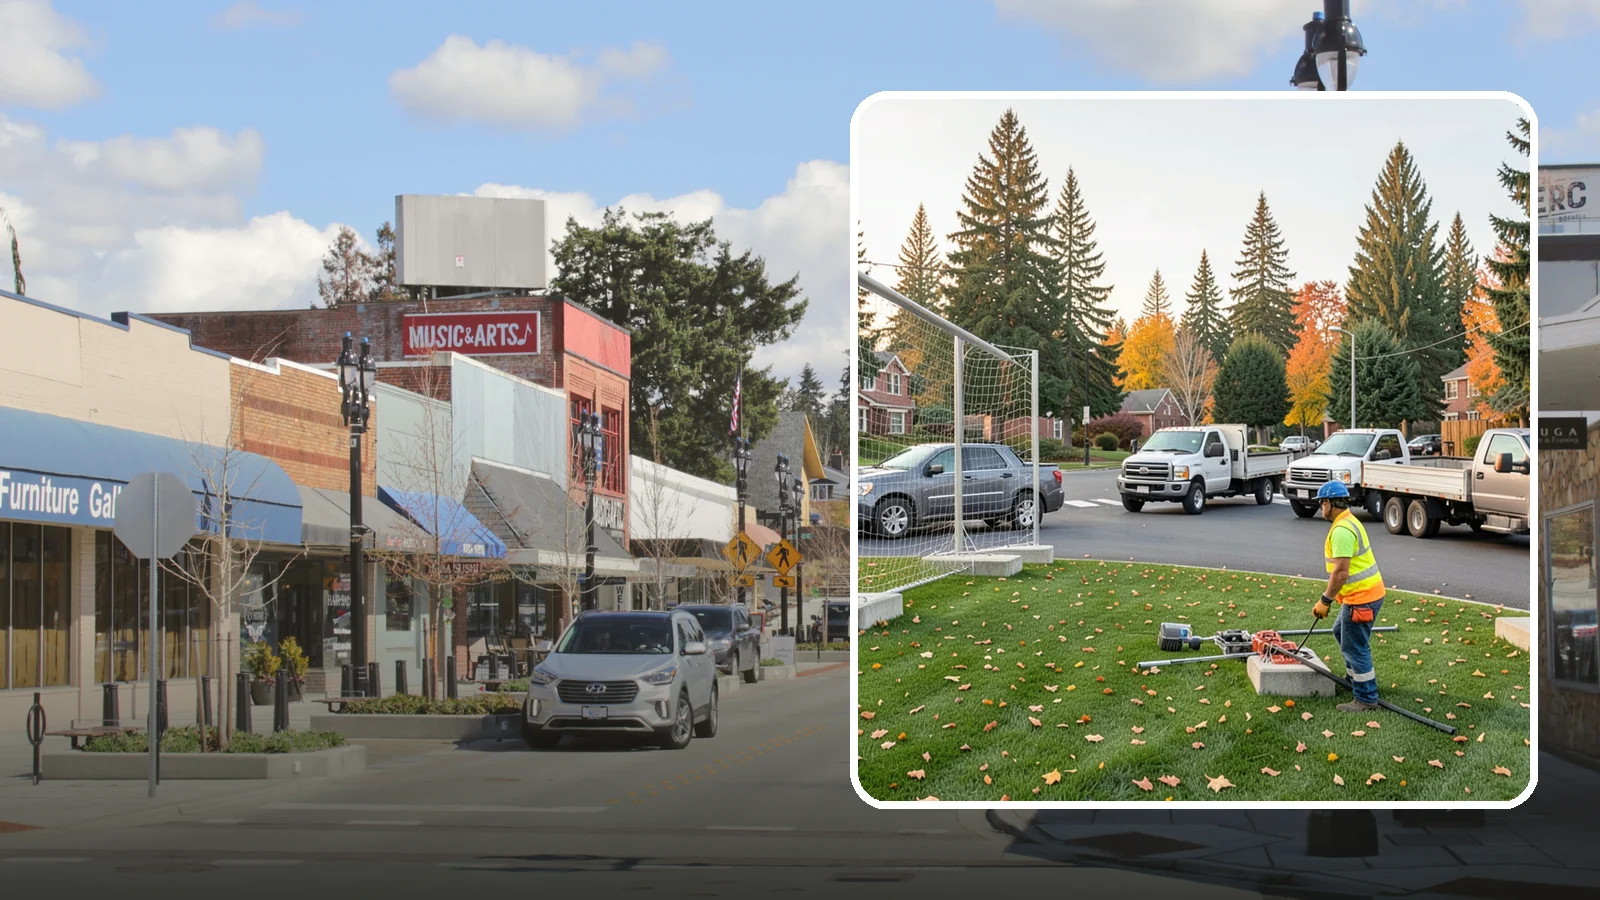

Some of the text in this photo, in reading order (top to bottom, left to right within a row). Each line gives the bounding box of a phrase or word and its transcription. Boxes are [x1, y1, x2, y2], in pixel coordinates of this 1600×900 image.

[408, 323, 519, 349] MUSIC&ARTS
[0, 471, 121, 519] Furniture Gal
